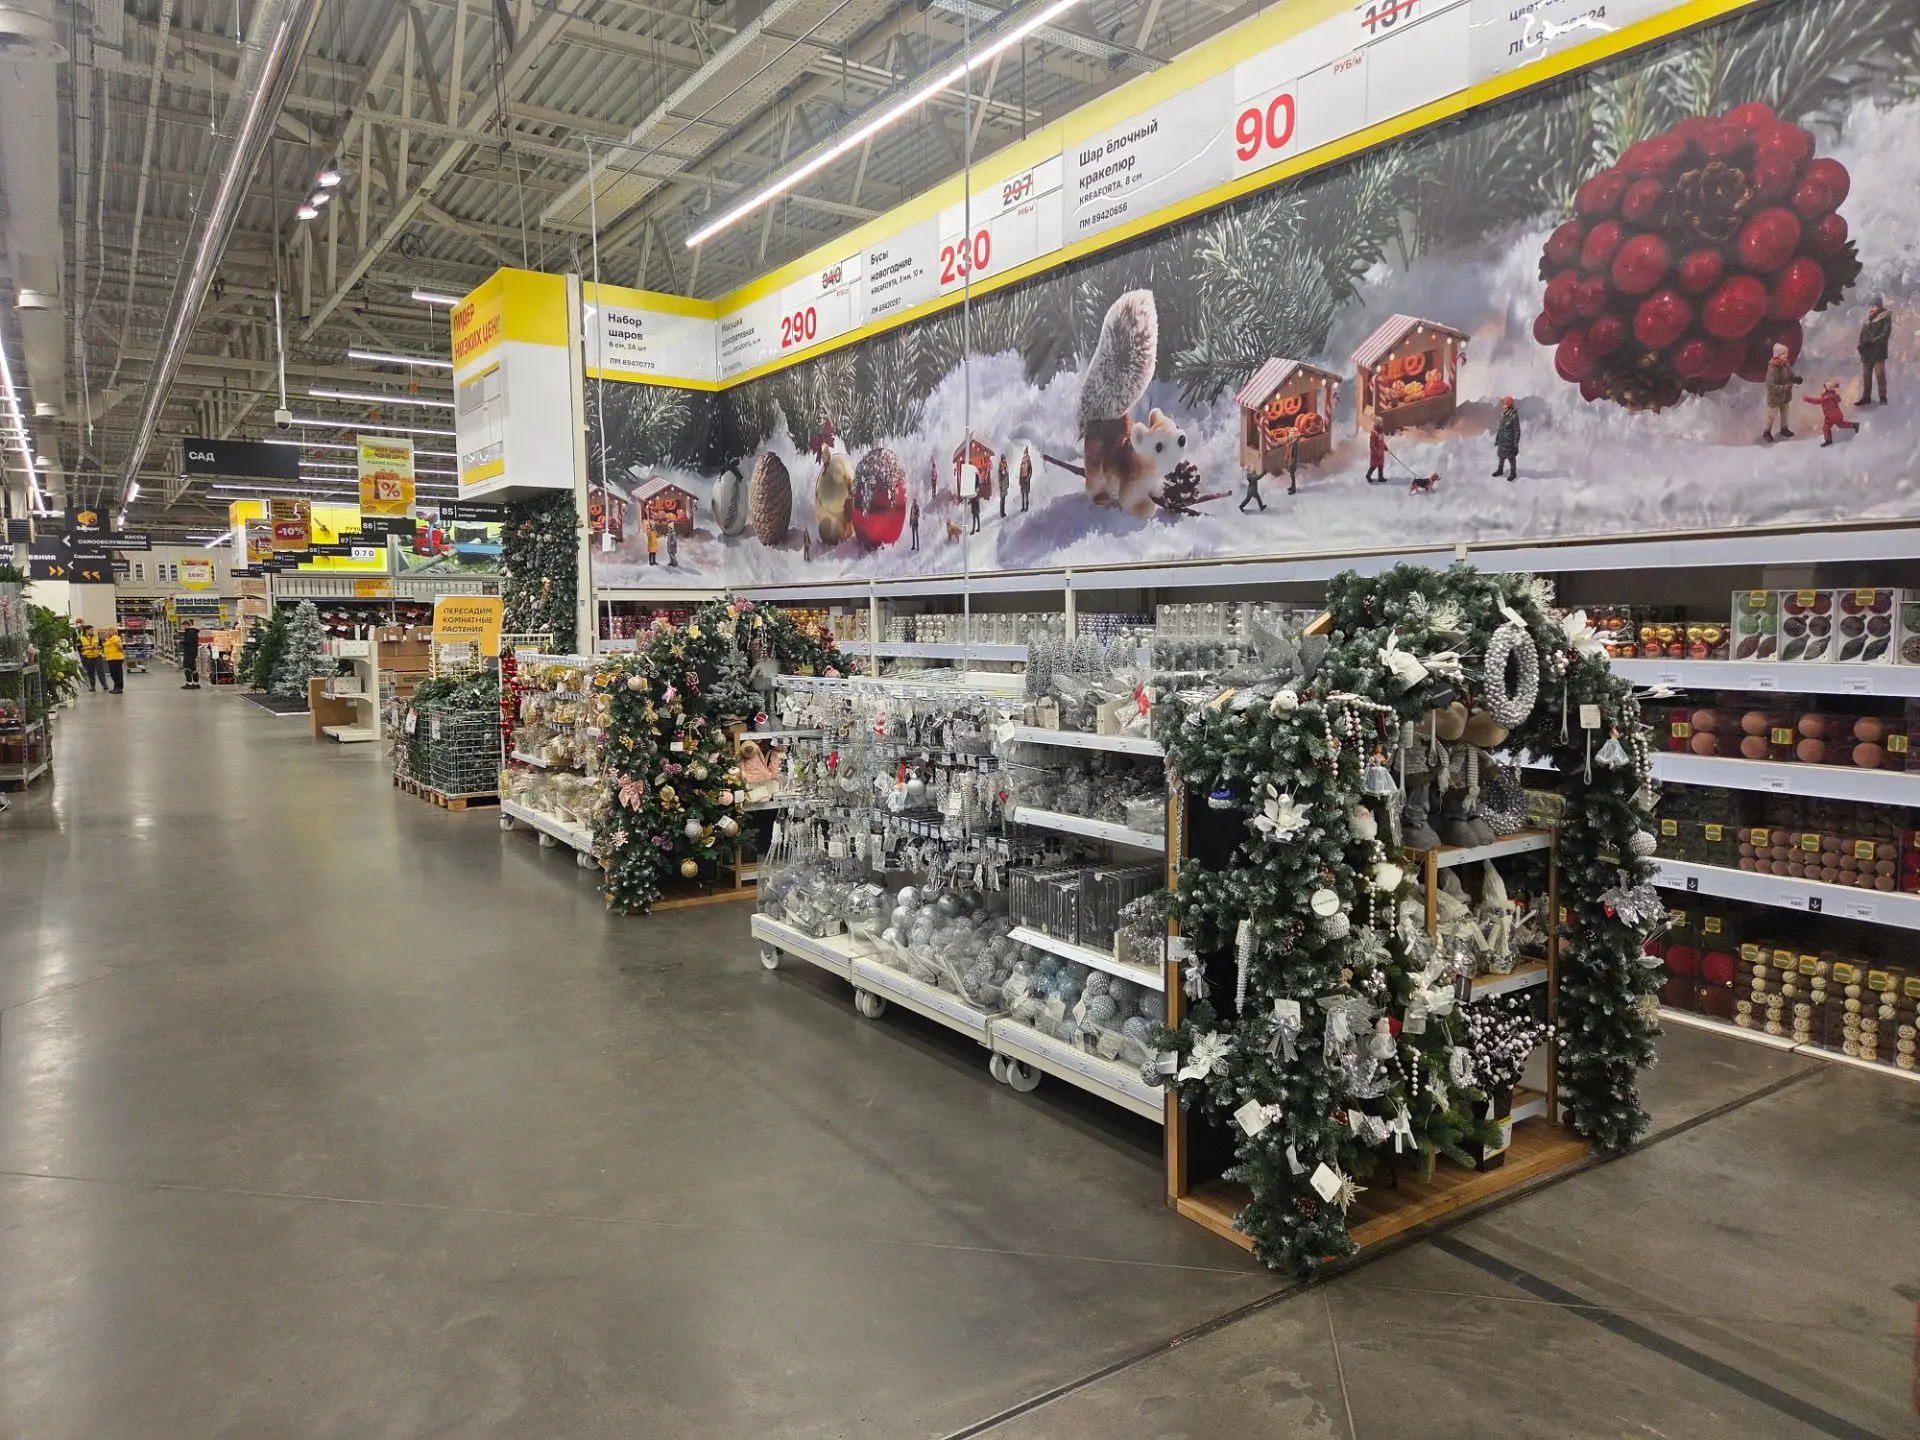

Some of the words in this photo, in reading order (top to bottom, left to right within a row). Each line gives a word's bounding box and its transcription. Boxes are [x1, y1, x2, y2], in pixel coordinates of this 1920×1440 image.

[1236, 93, 1295, 161] 90
[1080, 147, 1103, 166] Шар
[1106, 118, 1158, 154] ёлочный
[1080, 155, 1136, 189] кракелюр
[1003, 173, 1033, 206] 297
[1080, 217, 1091, 230] ЛМ
[870, 251, 889, 265] Бусы
[941, 229, 991, 285] 230
[870, 257, 912, 282] новогодние
[453, 303, 474, 335] ЛИДЕР
[608, 313, 642, 328] Набор
[781, 306, 817, 348] 290
[454, 327, 482, 361] НИЗКИХ
[608, 330, 643, 340] шаров
[188, 451, 215, 462] САД
[441, 508, 454, 516] 85
[277, 526, 305, 536] -10%
[442, 616, 493, 624] КОМНАТНЫЕ
[443, 607, 493, 615] ПЕРЕСАДИМ
